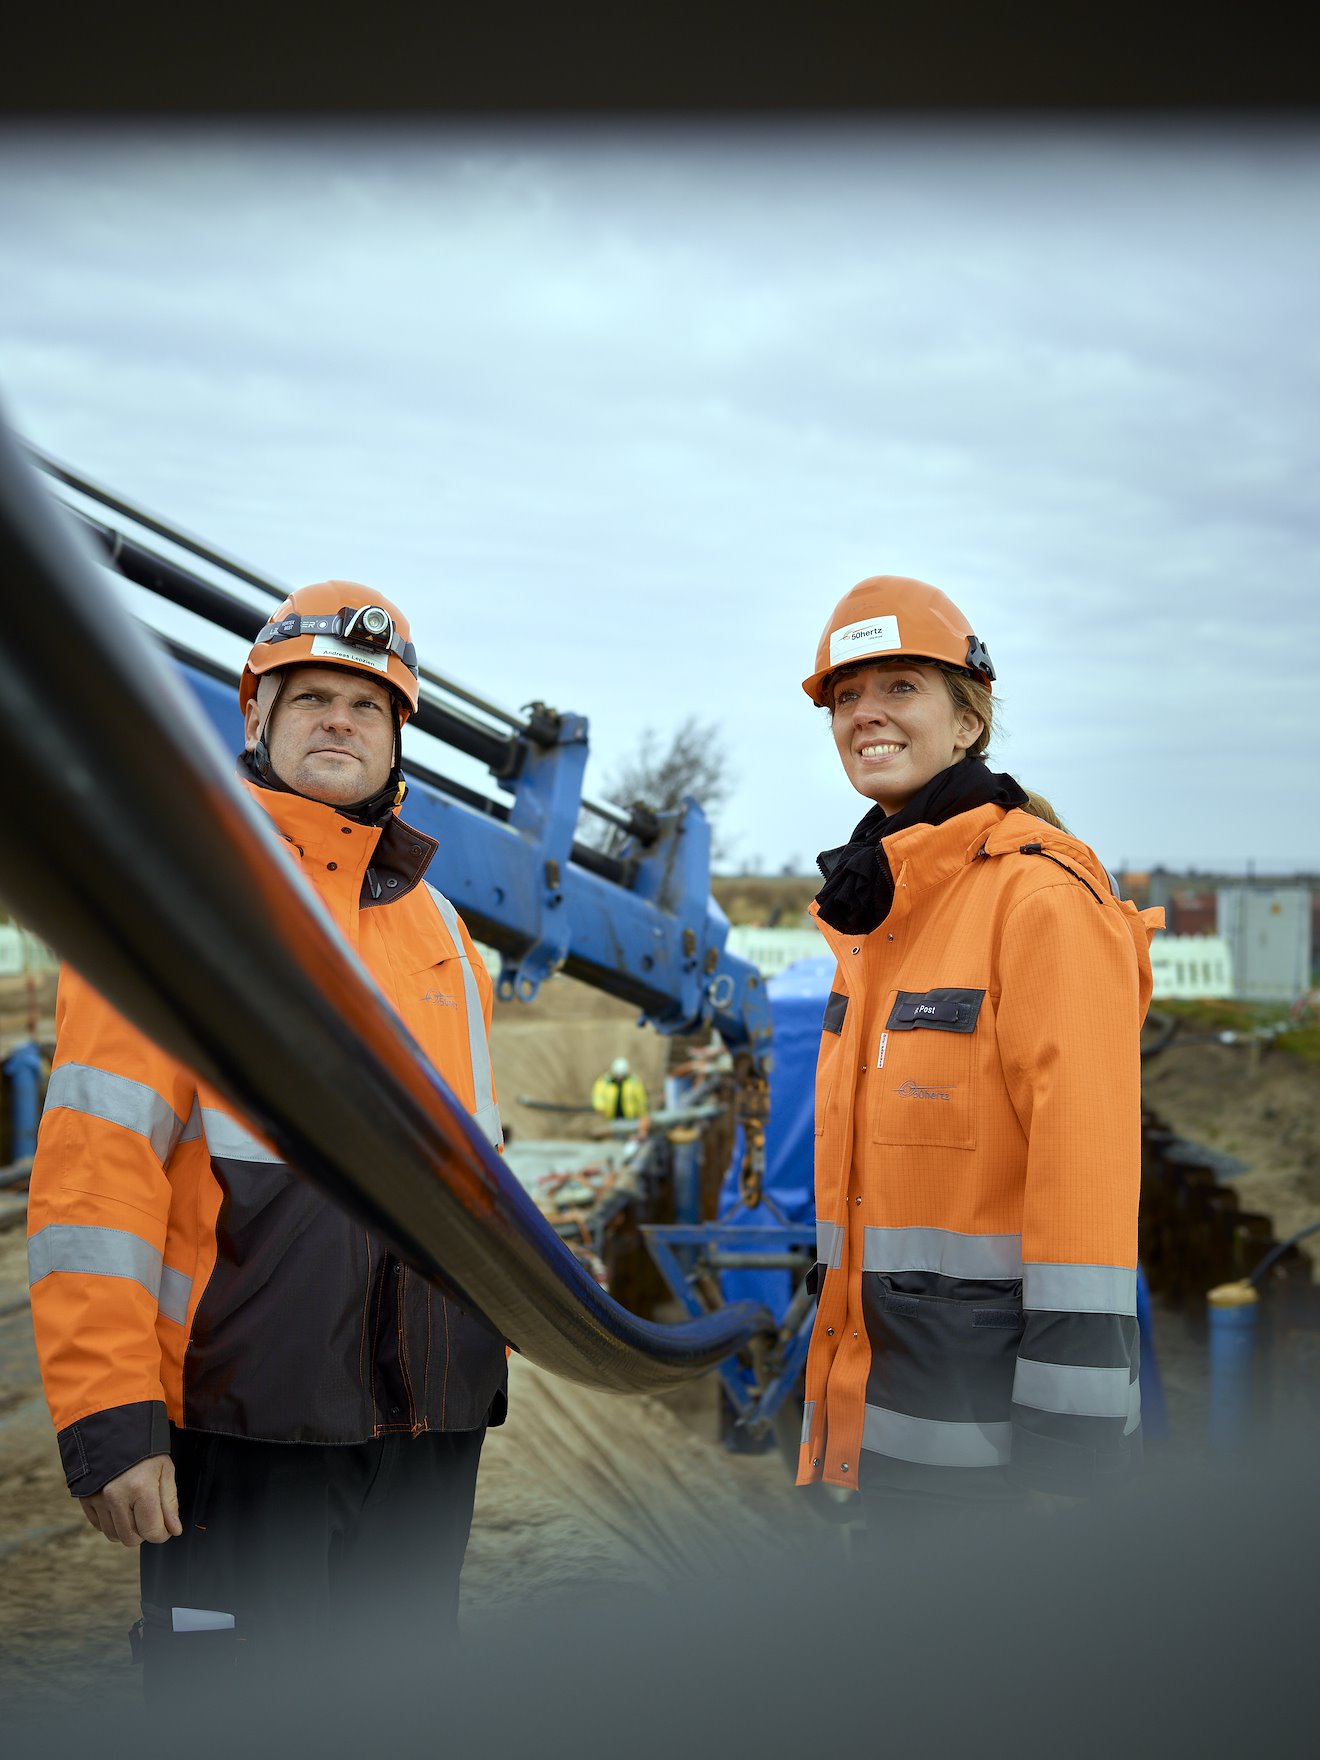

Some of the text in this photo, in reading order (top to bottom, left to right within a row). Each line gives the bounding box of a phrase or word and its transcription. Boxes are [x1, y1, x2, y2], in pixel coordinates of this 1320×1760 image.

[851, 628, 883, 641] 50hertz
[323, 650, 350, 659] Andreas
[919, 1005, 936, 1014] Post
